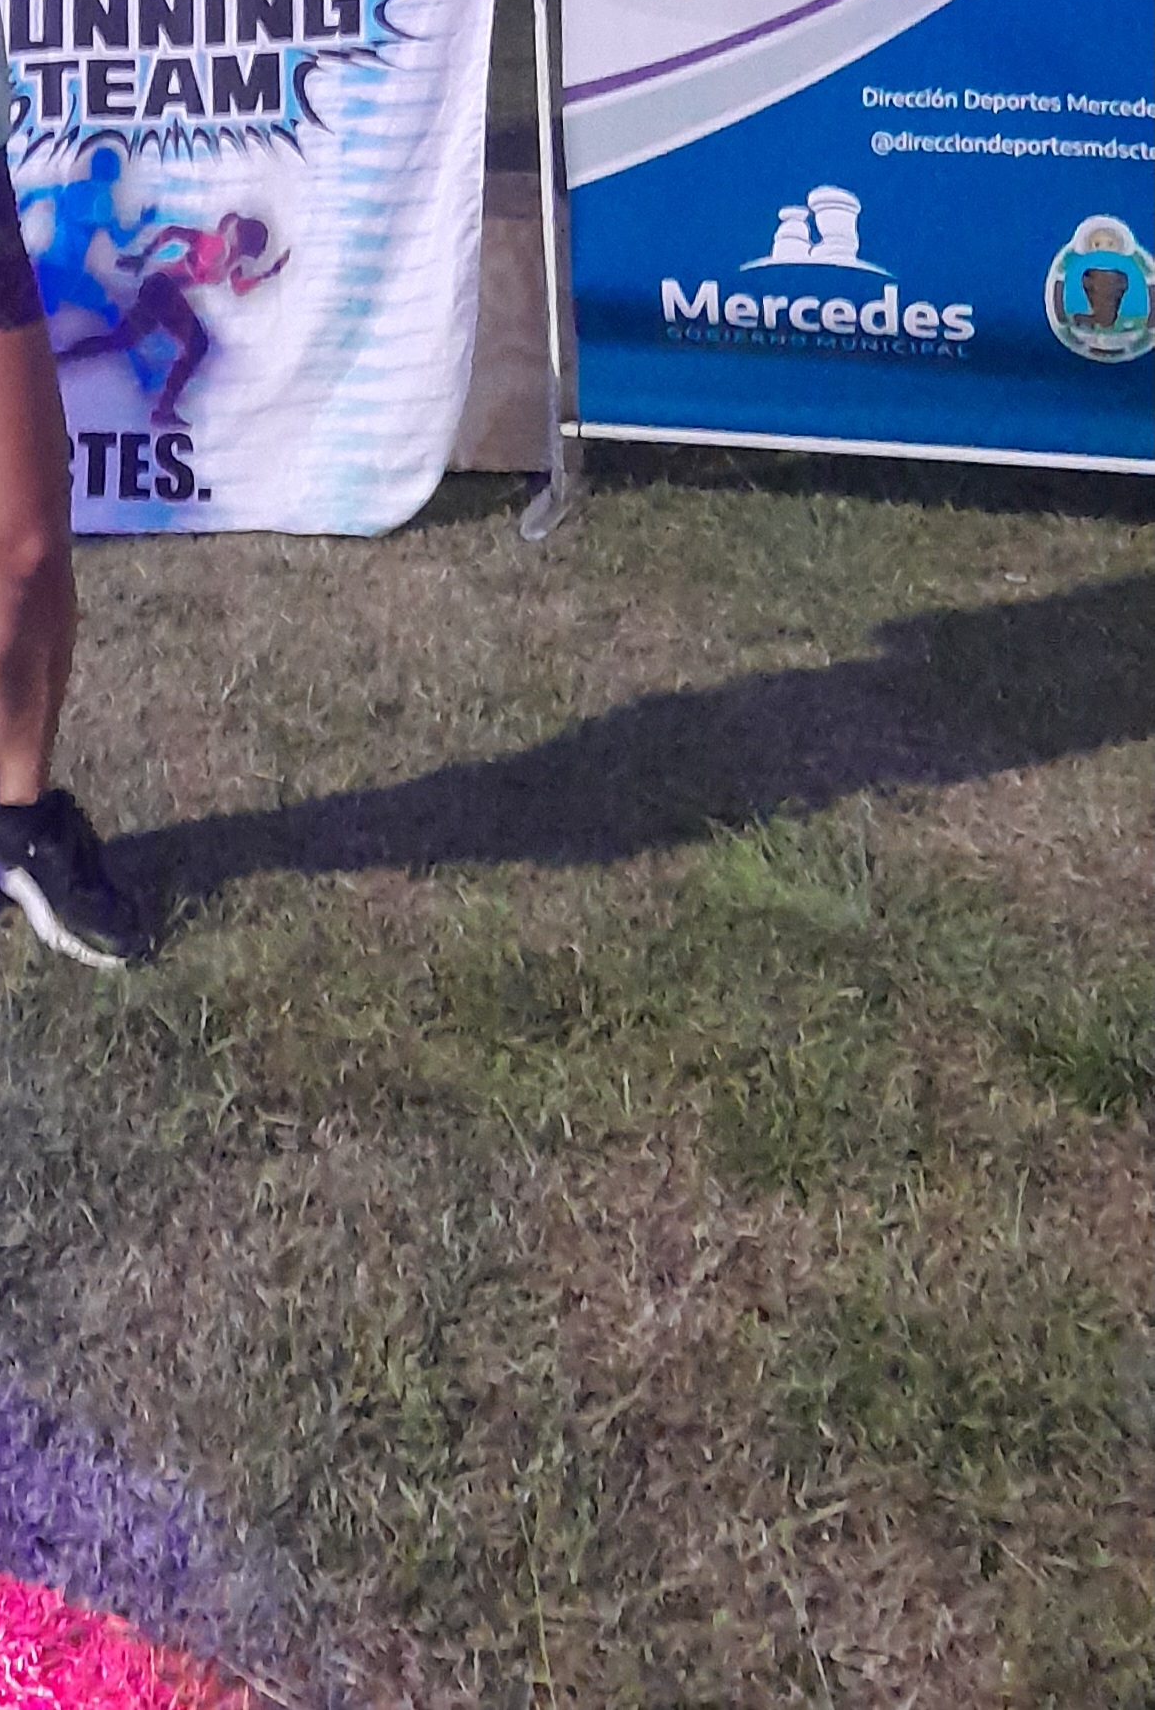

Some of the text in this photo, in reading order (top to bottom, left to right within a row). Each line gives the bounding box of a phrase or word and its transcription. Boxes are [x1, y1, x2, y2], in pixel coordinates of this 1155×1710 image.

[25, 53, 282, 120] TEAM
[862, 85, 958, 109] Dirección
[964, 88, 1061, 114] Deportes
[660, 277, 976, 341] Mercedes
